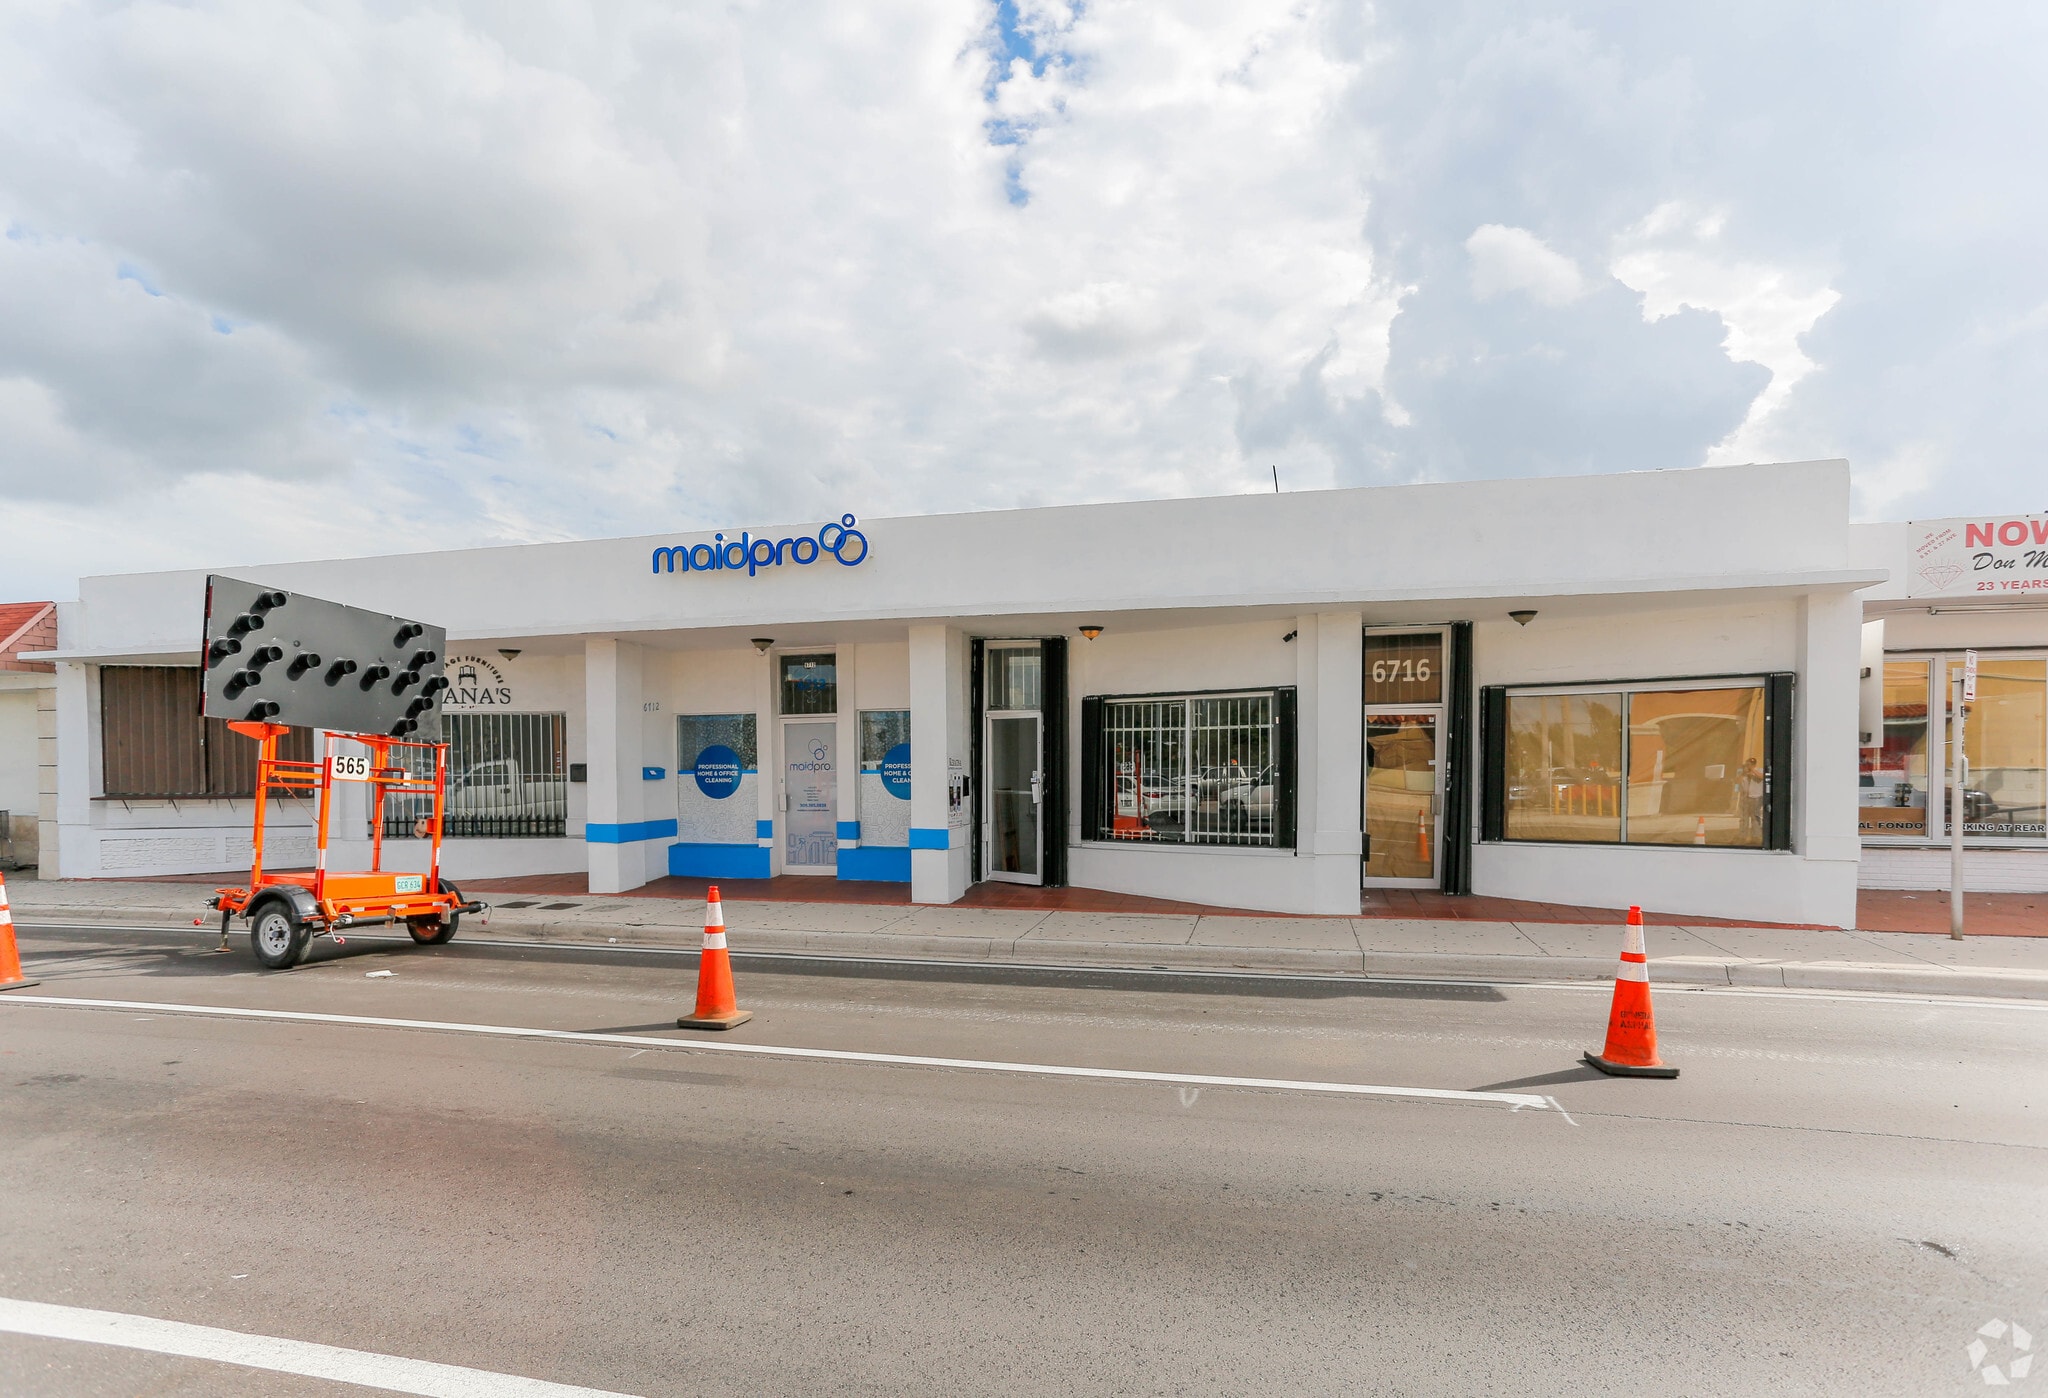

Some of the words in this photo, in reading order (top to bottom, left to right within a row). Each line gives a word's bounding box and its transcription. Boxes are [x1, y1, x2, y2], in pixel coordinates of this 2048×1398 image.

[1916, 539, 1935, 553] MOVED
[1935, 528, 1952, 540] FROM
[1924, 532, 1934, 540] WE
[1946, 533, 1957, 543] AVE
[652, 531, 819, 577] maidpro
[1972, 552, 2016, 571] Don
[1976, 581, 1995, 591] 23
[2000, 579, 2048, 590] YEARS
[465, 655, 504, 684] FURNITURE
[1372, 658, 1431, 683] 6716
[336, 756, 365, 775] 565
[789, 760, 831, 773] maidpro
[1878, 822, 1923, 830] FONDO
[1997, 824, 2013, 832] AT
[2014, 824, 2045, 832] REAR
